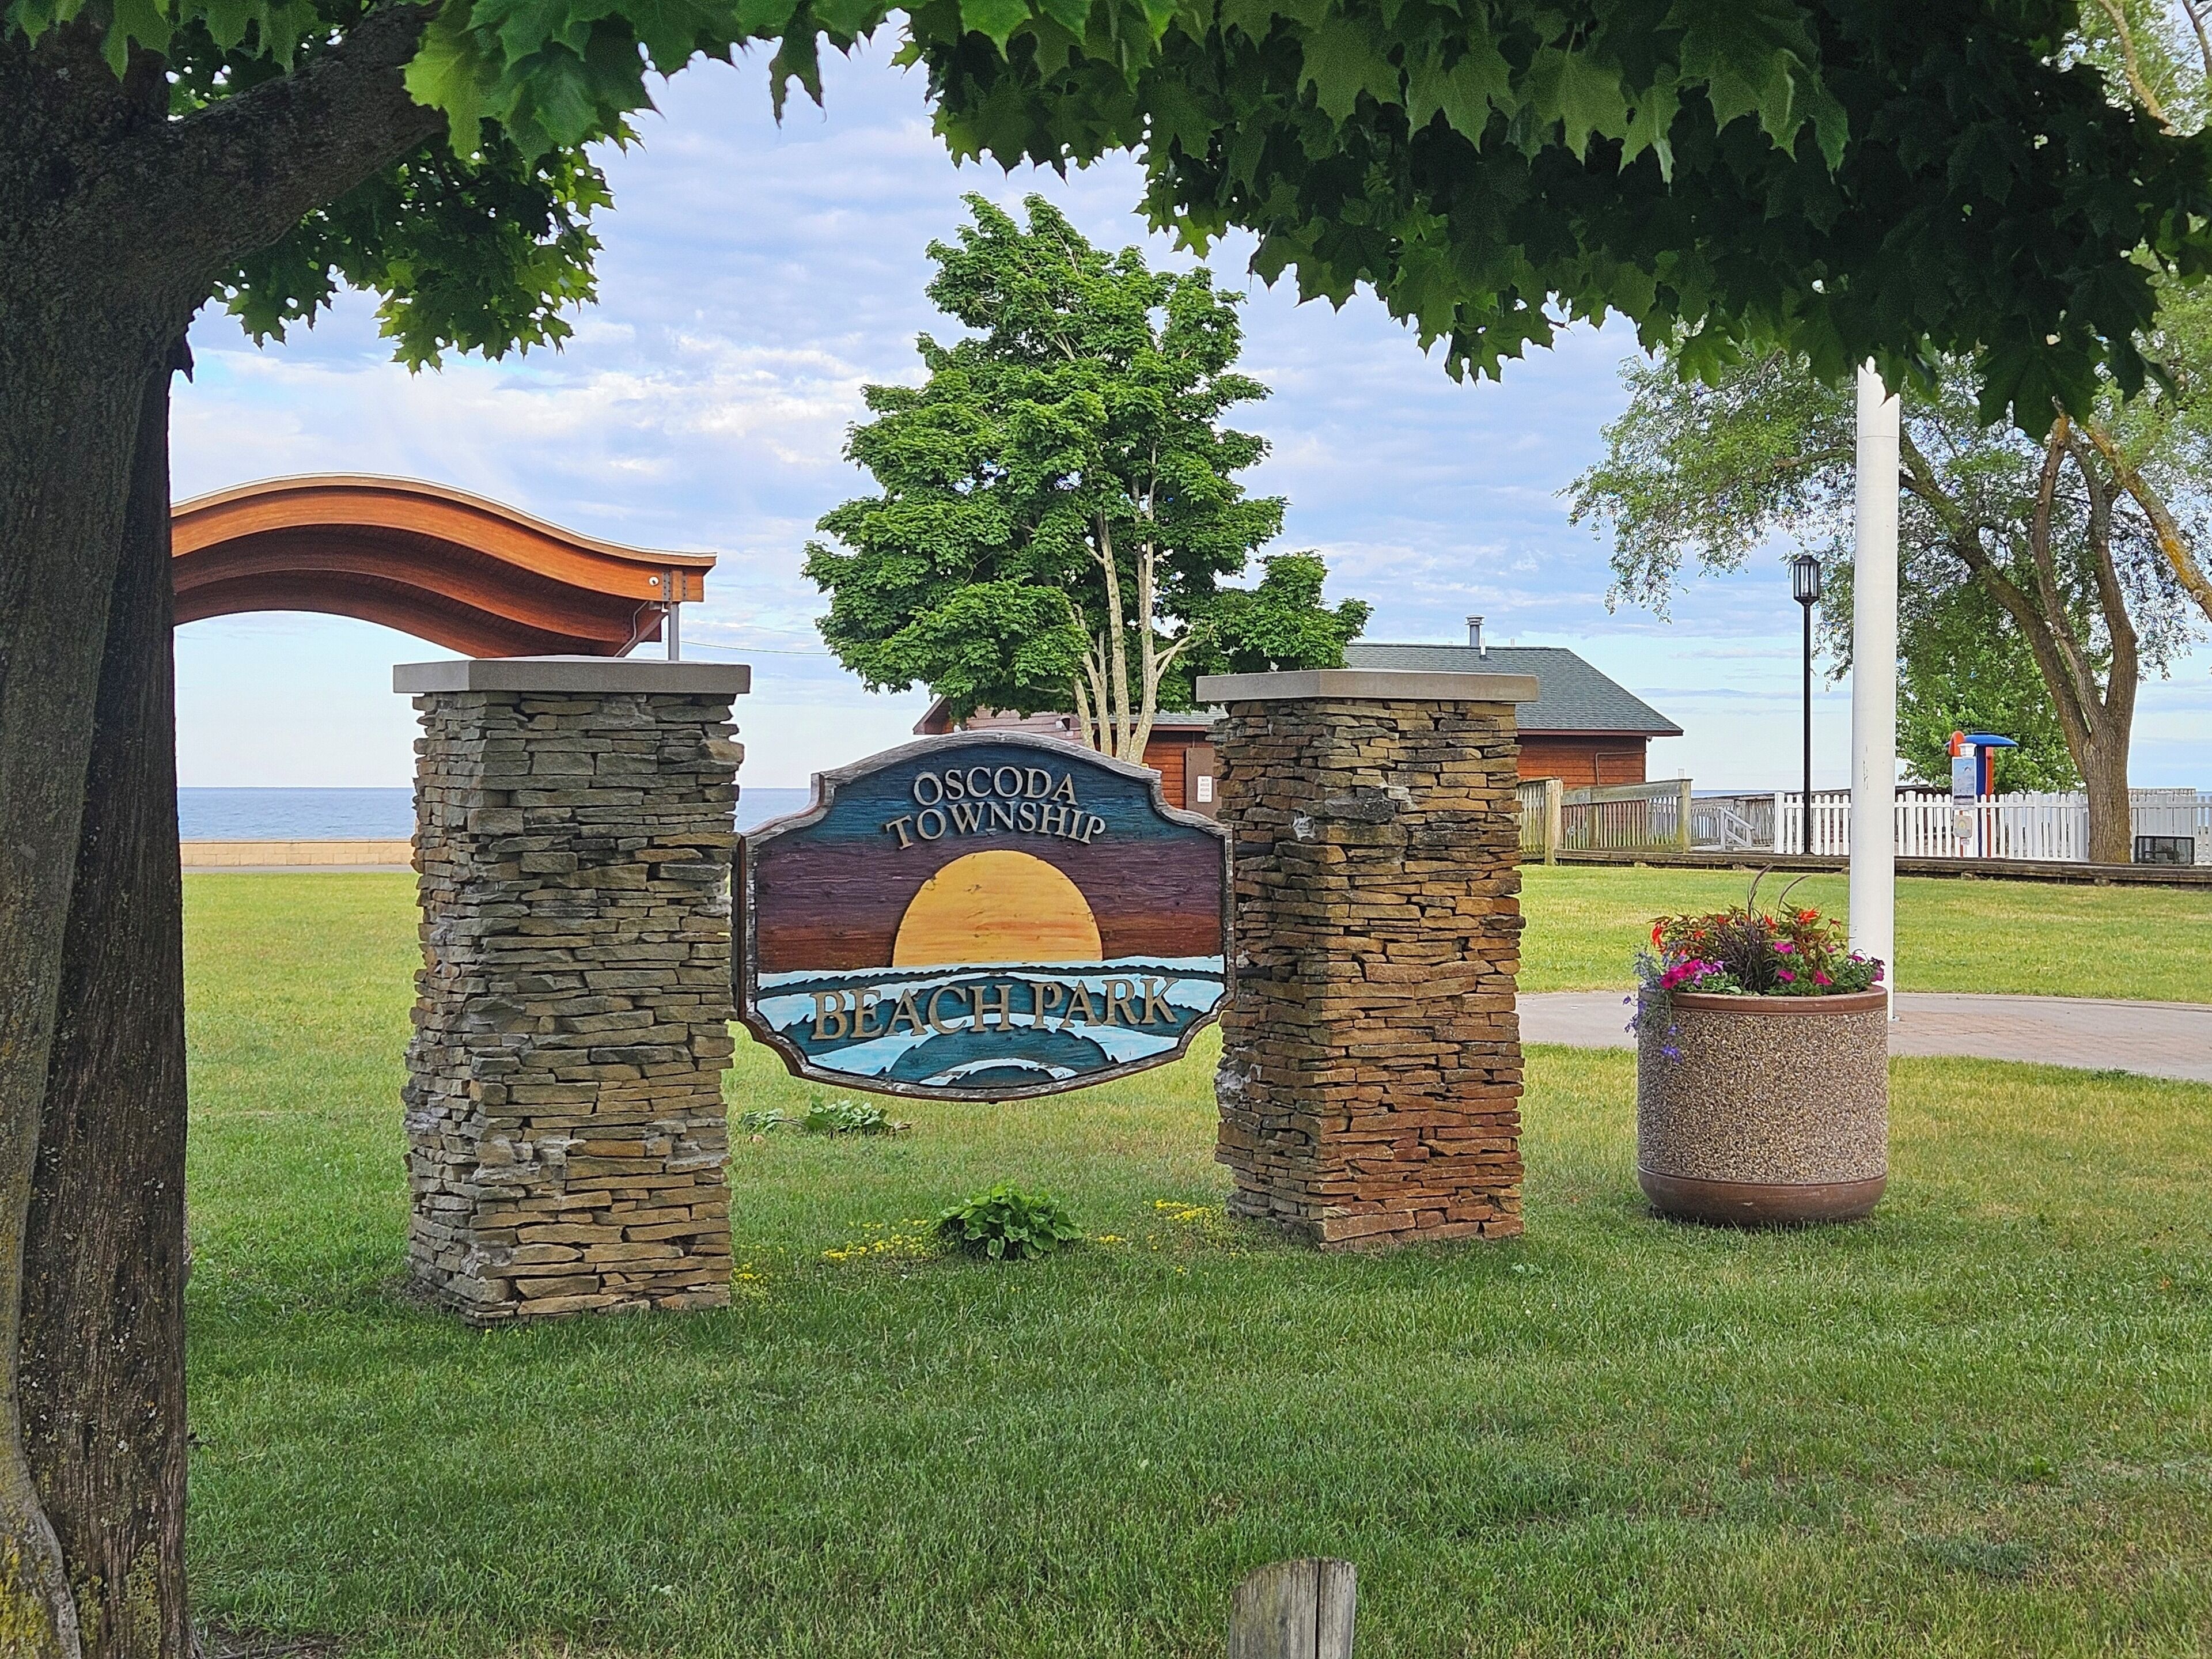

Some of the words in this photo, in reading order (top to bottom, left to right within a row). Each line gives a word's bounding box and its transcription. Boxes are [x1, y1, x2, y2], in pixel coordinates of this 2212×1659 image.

[914, 766, 1078, 806] OSCODA
[886, 801, 1106, 850] TOWNSHIP
[811, 983, 1012, 1039] BEACH
[1035, 979, 1179, 1030] PARK
